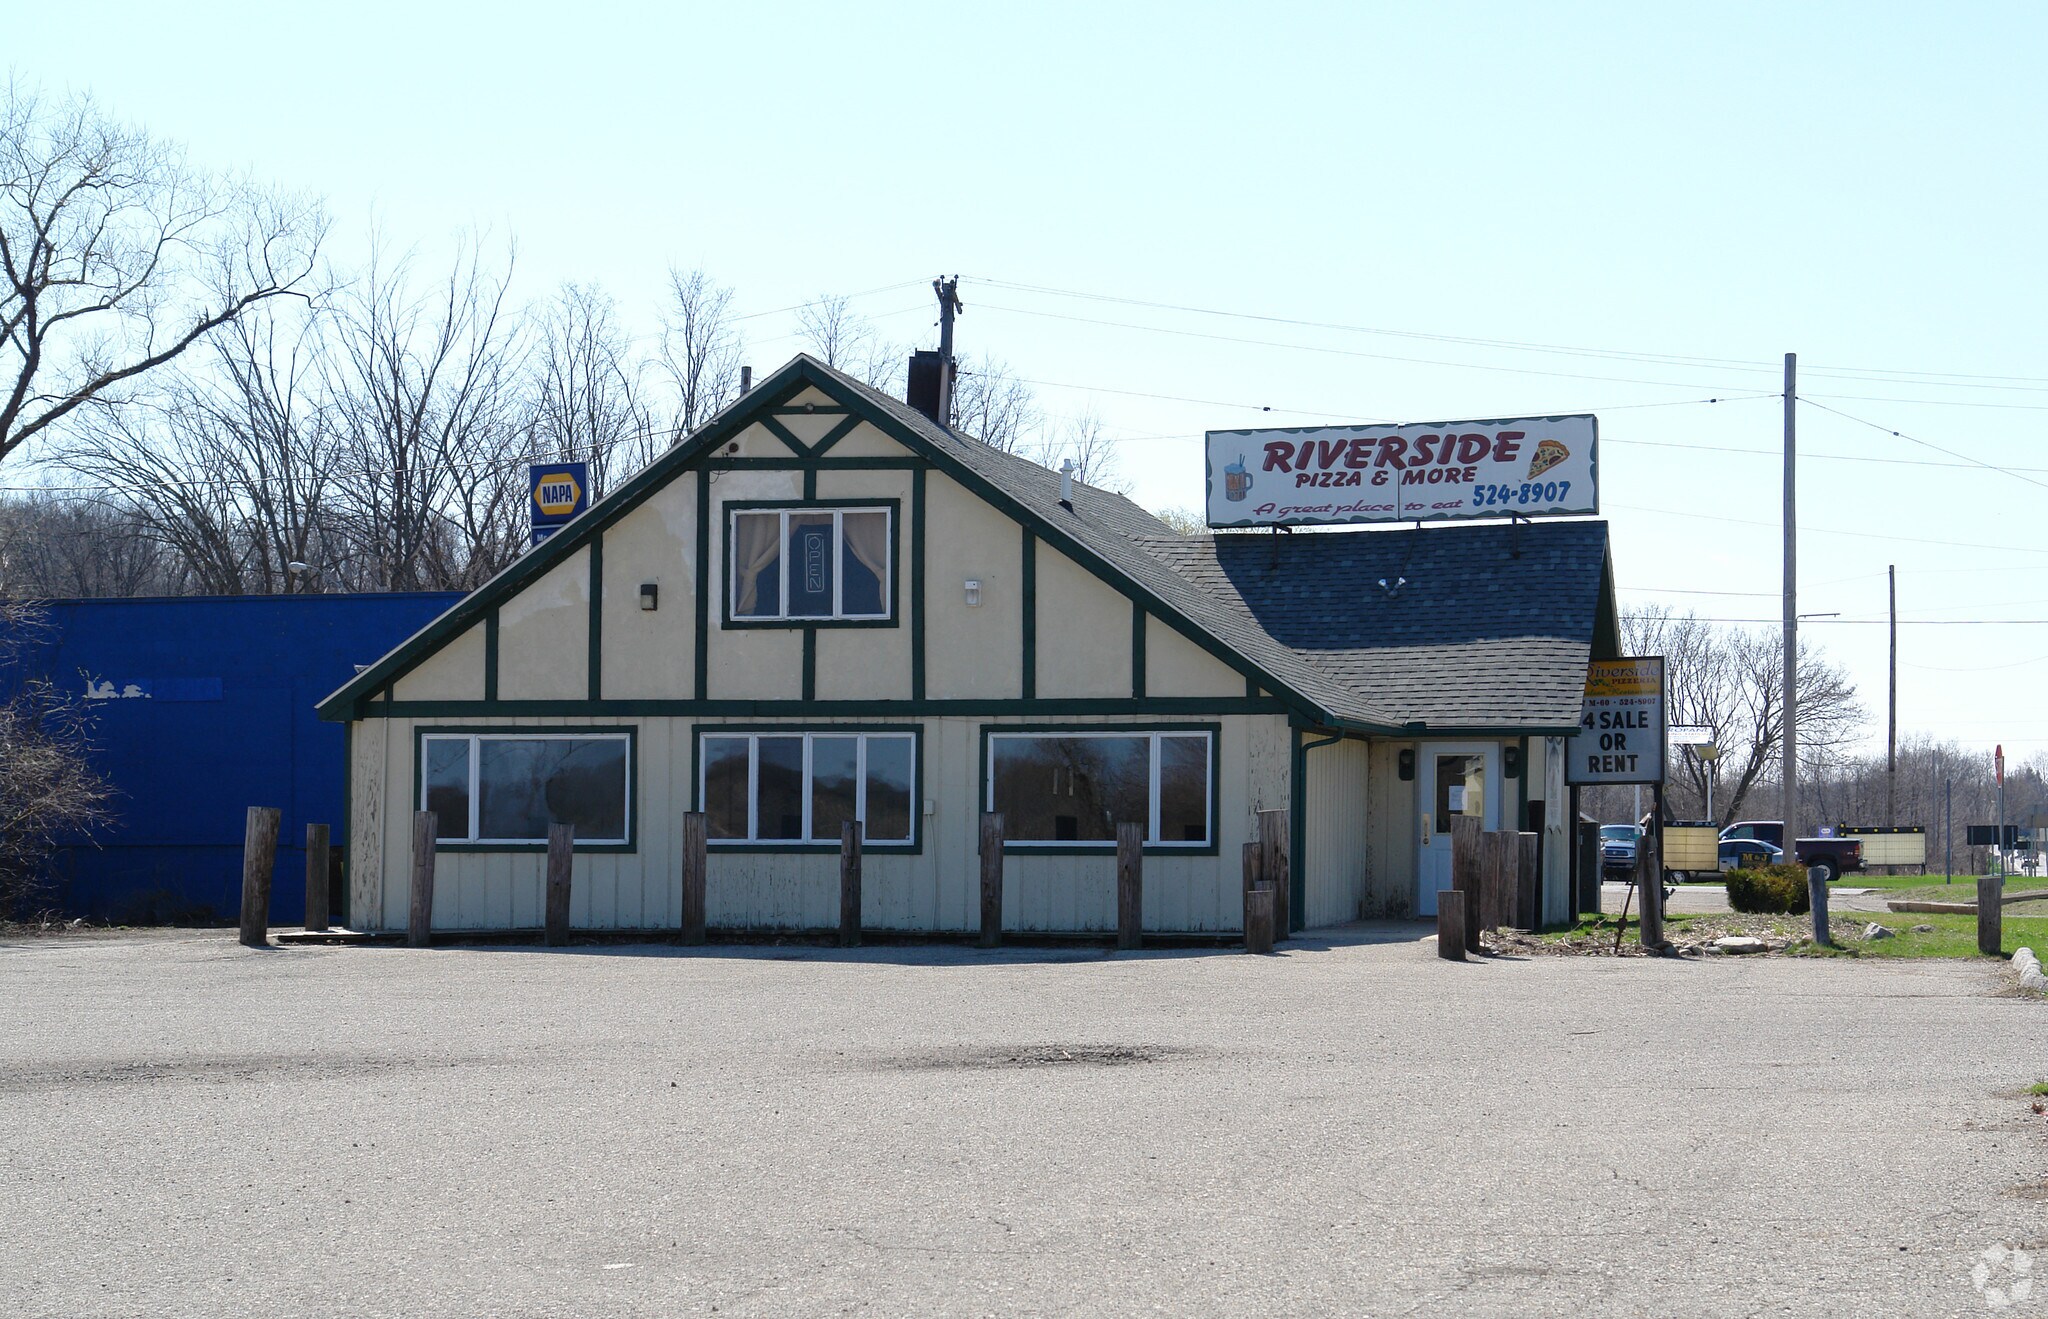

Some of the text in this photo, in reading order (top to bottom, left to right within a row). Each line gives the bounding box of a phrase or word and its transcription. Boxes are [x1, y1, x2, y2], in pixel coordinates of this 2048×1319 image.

[1262, 431, 1526, 474] RIVERSIDE
[1295, 466, 1478, 488] PIZZA & MORE
[542, 484, 573, 504] NAPA
[1472, 480, 1571, 507] 524-8907
[1253, 499, 1464, 518] A great place to eat
[808, 535, 821, 590] OPEN
[1612, 677, 1657, 685] PIZZERIA
[1582, 711, 1648, 729] 4 SALE
[1600, 733, 1626, 751] OR
[1588, 754, 1638, 773] RENT
